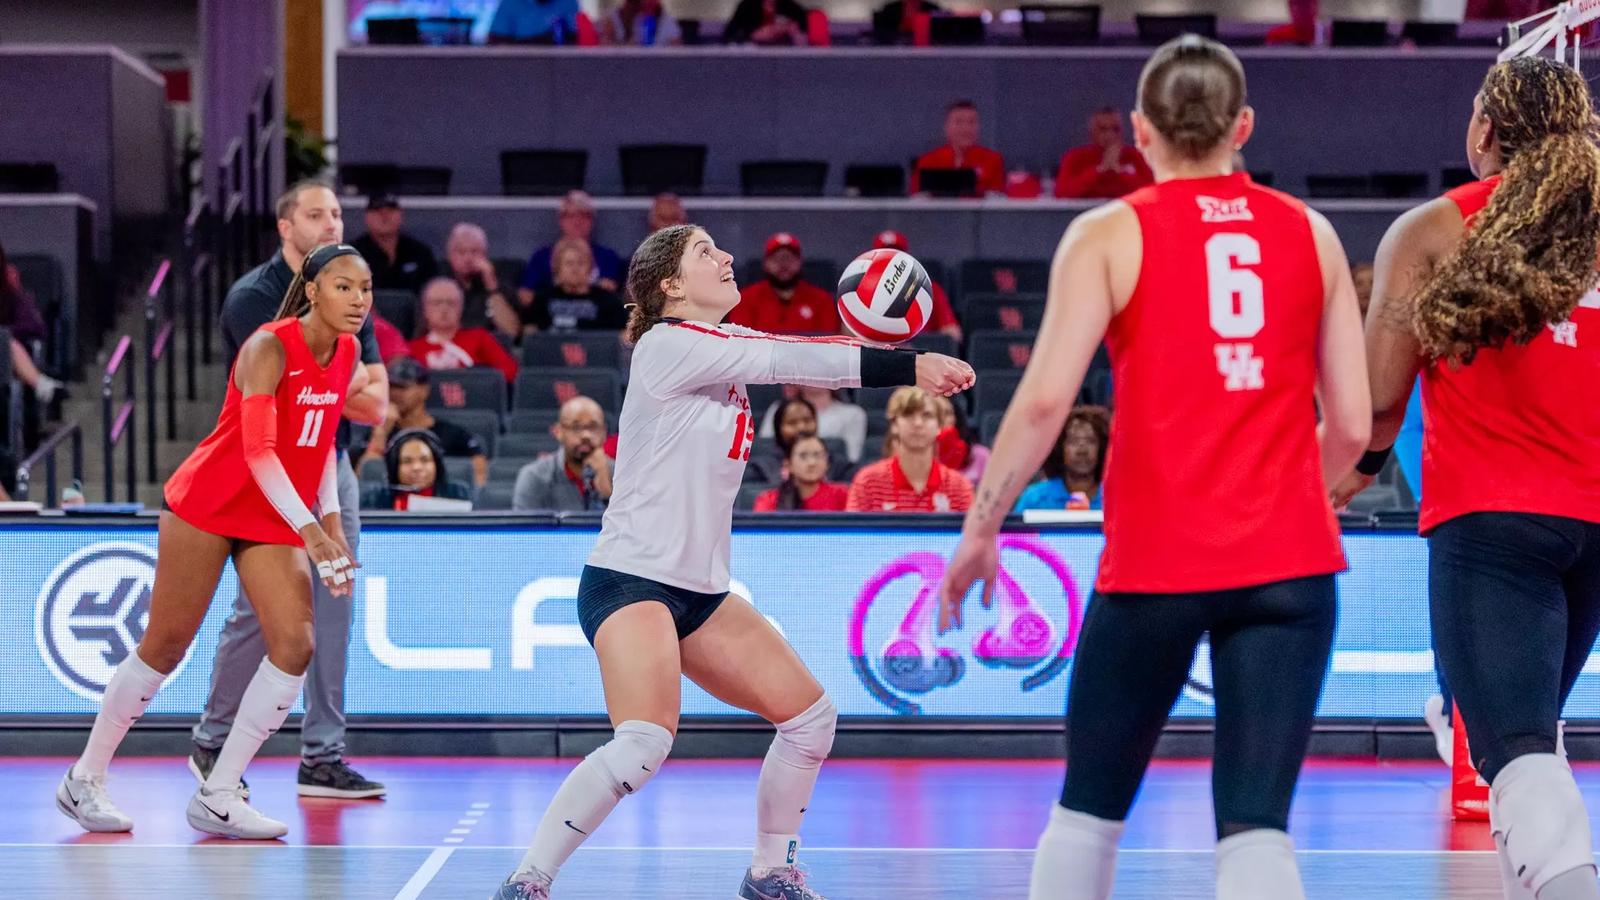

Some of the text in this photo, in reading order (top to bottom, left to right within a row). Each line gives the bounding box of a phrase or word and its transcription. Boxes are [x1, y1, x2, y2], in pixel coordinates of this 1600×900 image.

[884, 259, 908, 296] Baden
[1204, 232, 1265, 338] 6
[1213, 342, 1265, 391] UH
[296, 385, 339, 406] Houston
[296, 409, 325, 447] 11
